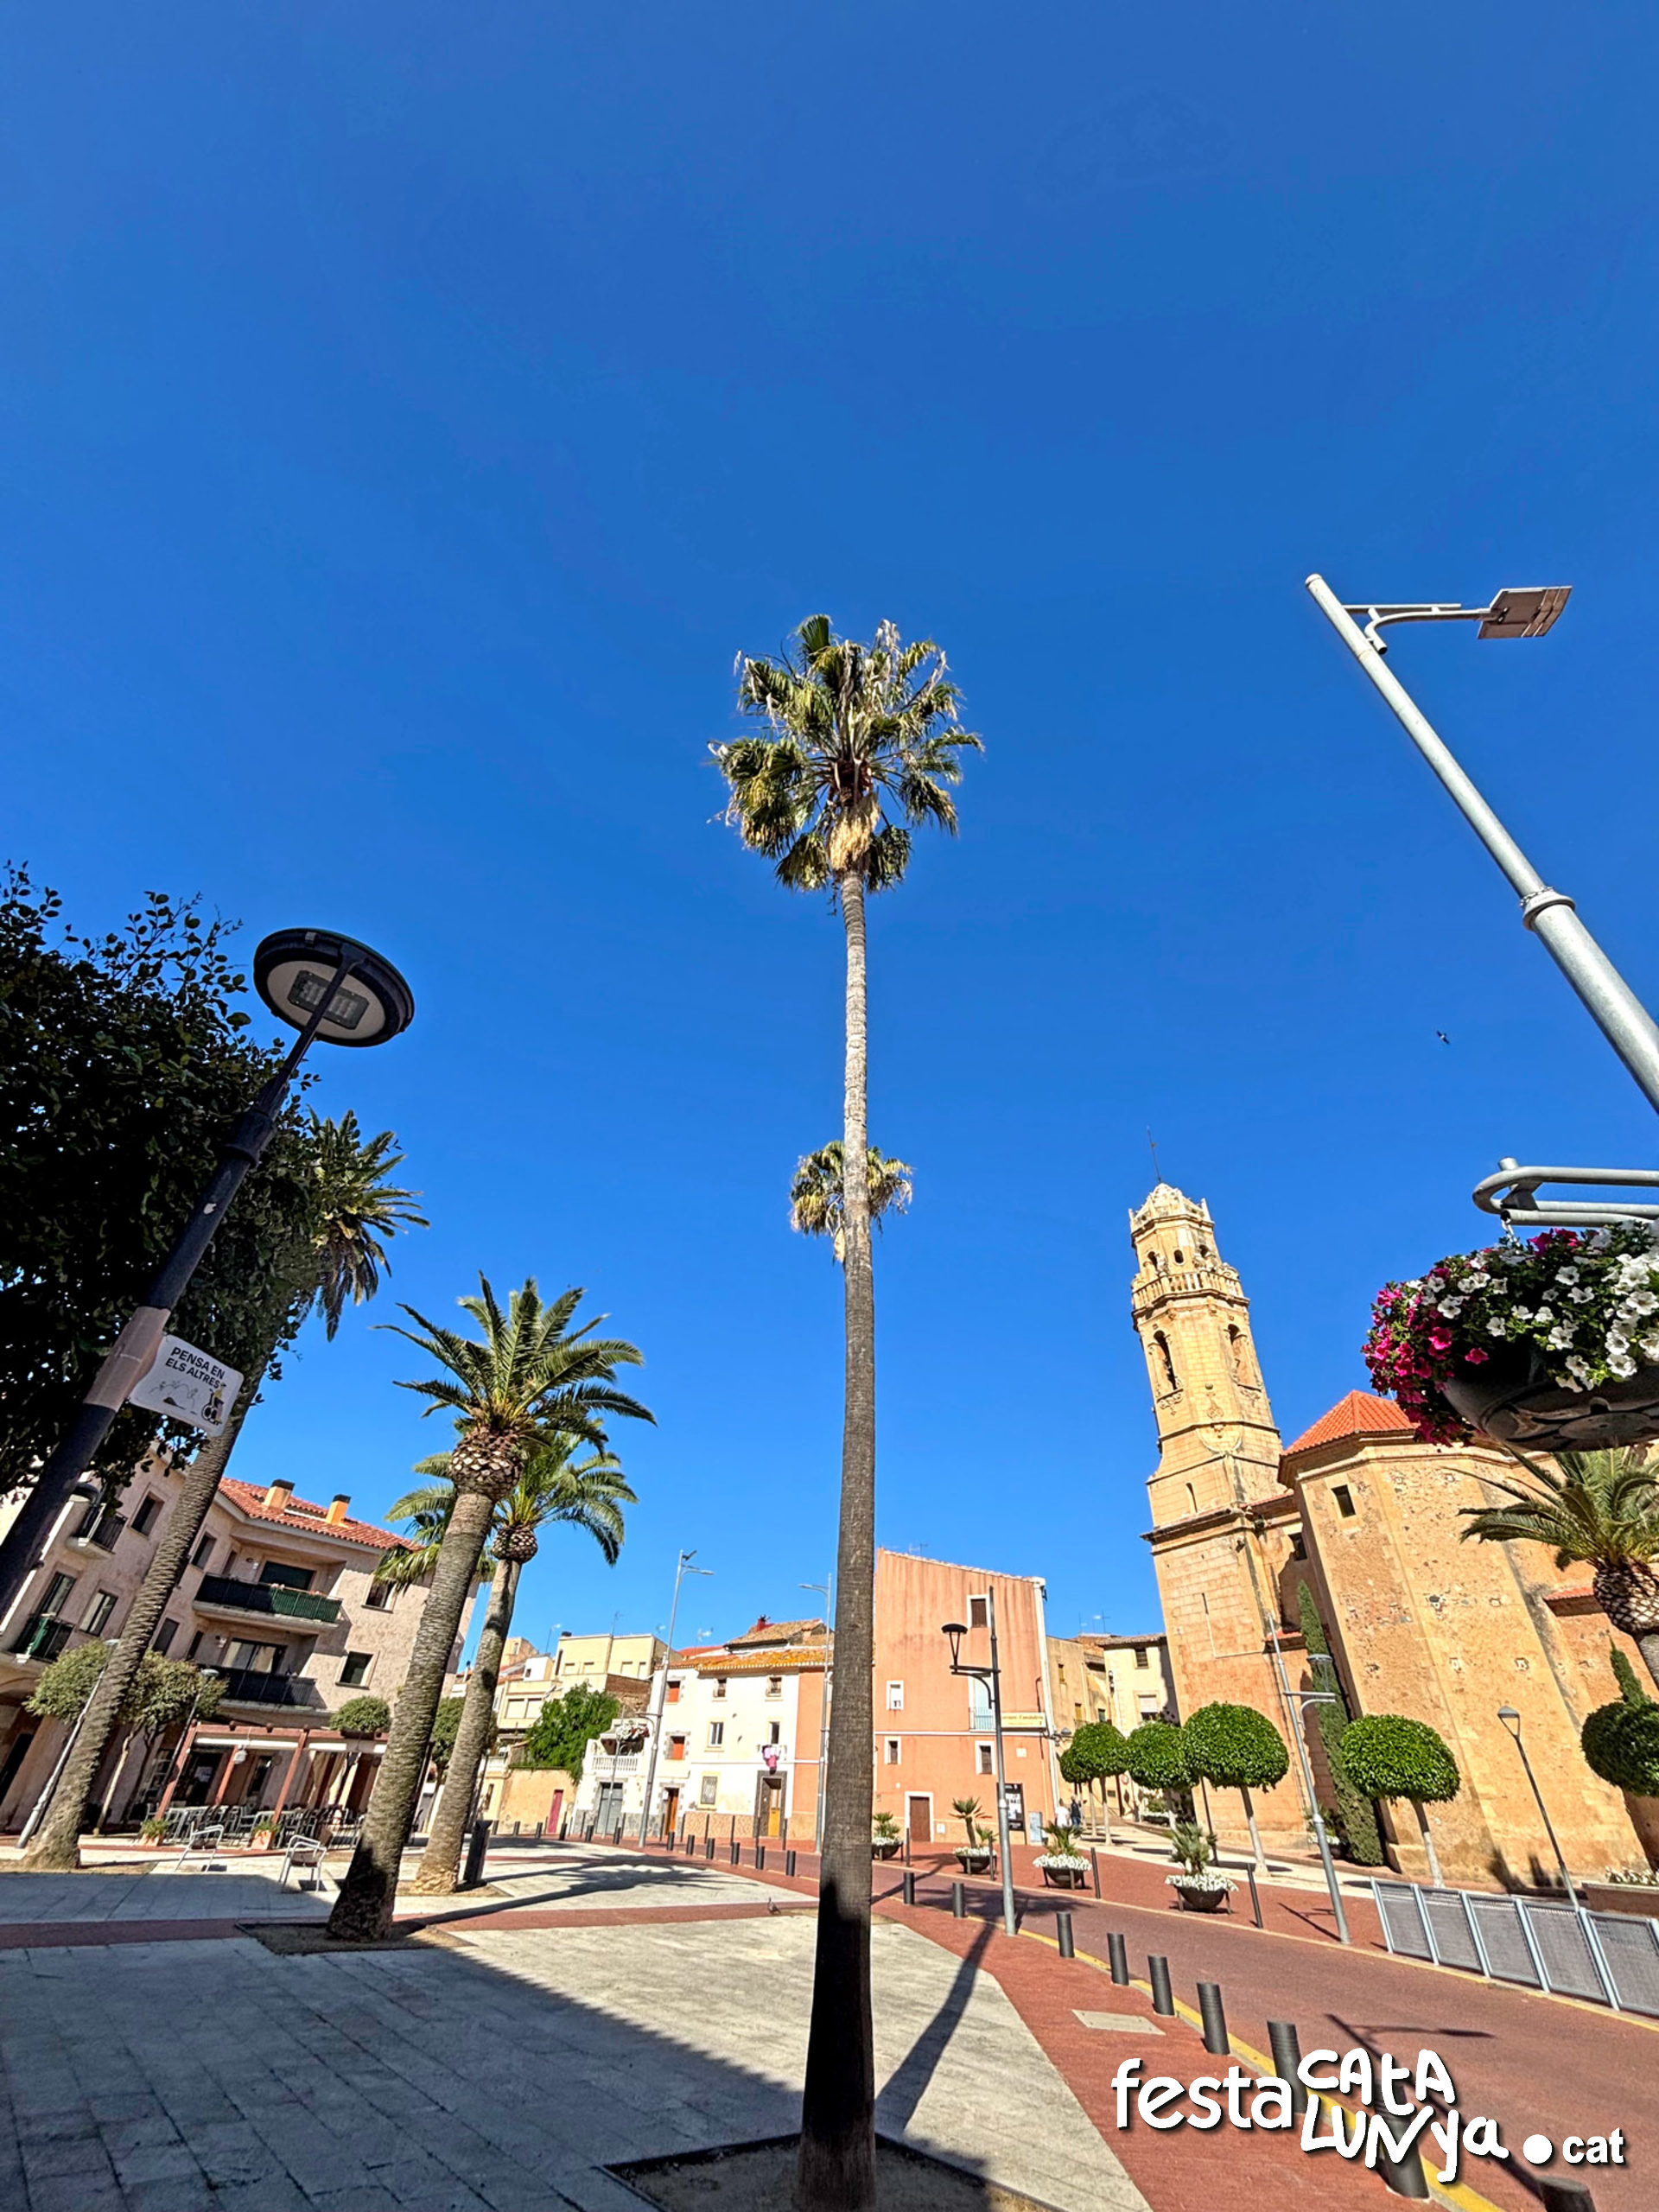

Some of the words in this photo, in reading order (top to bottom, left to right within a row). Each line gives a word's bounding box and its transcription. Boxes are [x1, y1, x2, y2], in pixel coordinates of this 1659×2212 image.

[165, 1357, 187, 1372] ELS
[186, 1367, 220, 1389] ALTRES
[170, 1346, 210, 1371] PENSA
[211, 1365, 226, 1380] EN
